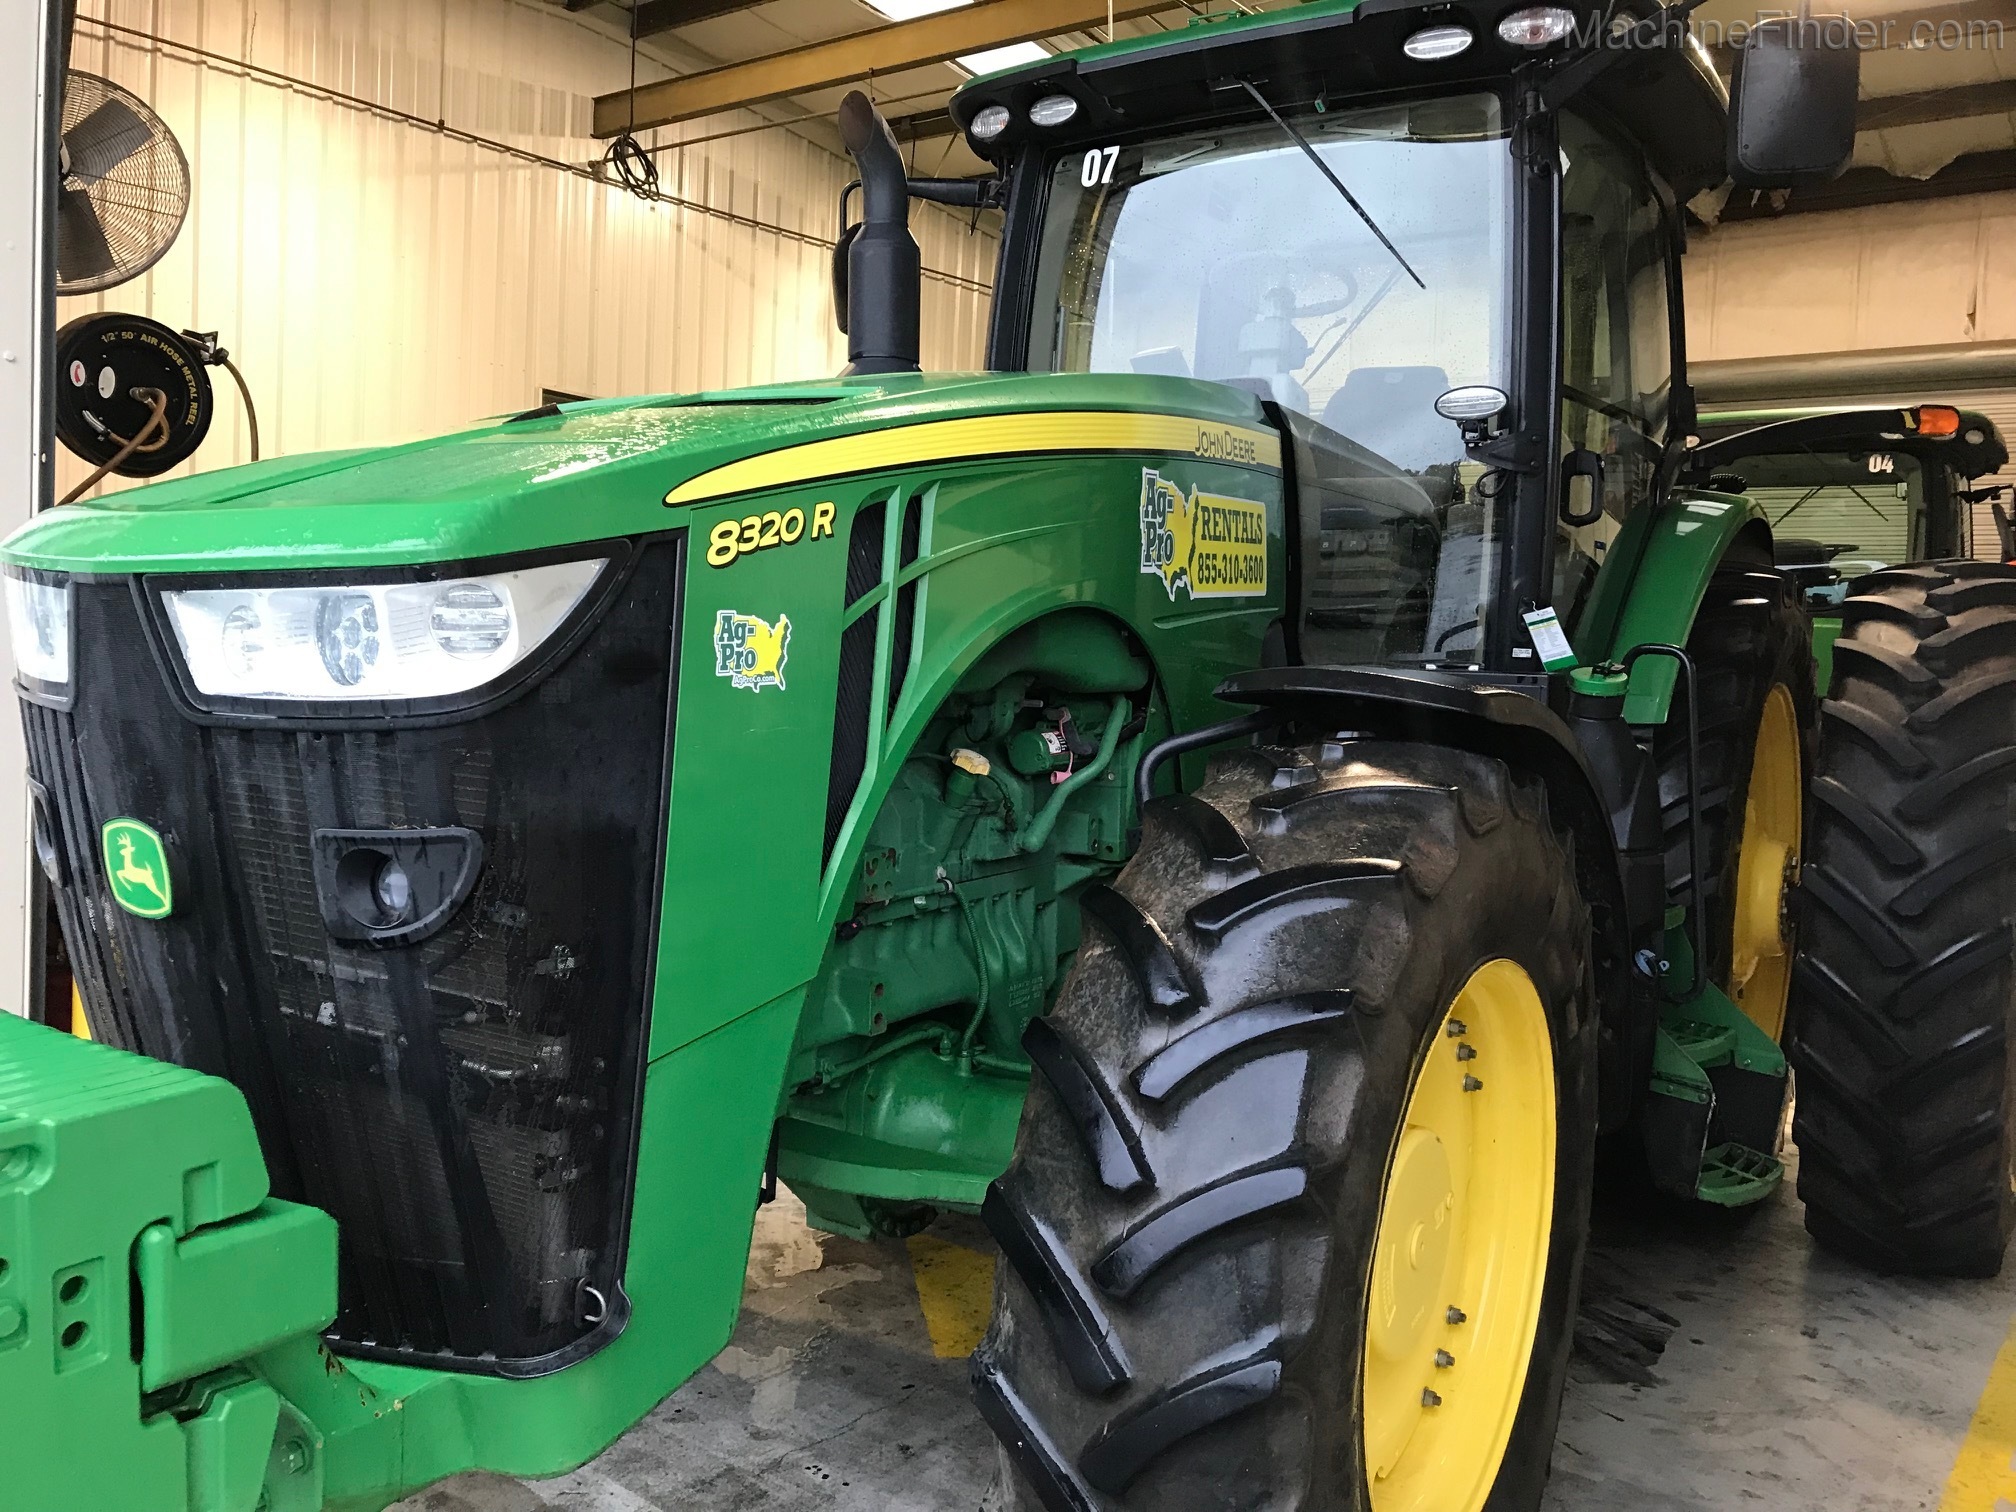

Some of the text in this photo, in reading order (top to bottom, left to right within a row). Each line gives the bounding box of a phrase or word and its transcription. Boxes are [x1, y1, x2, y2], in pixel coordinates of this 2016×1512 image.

[1081, 145, 1120, 188] 07
[140, 333, 159, 346] AIR
[159, 342, 185, 366] HOSE
[181, 366, 198, 400] METAL
[185, 401, 198, 425] REEL
[1195, 425, 1256, 462] JOHN DEERE
[1868, 453, 1894, 474] 04
[1144, 476, 1174, 530] Ag-
[706, 501, 836, 569] 8320 R
[1200, 505, 1263, 545] RENTALS
[1144, 520, 1174, 565] Pro
[1197, 552, 1264, 584] 855-310-3600
[718, 614, 756, 648] Ag-
[719, 643, 757, 671] Pro
